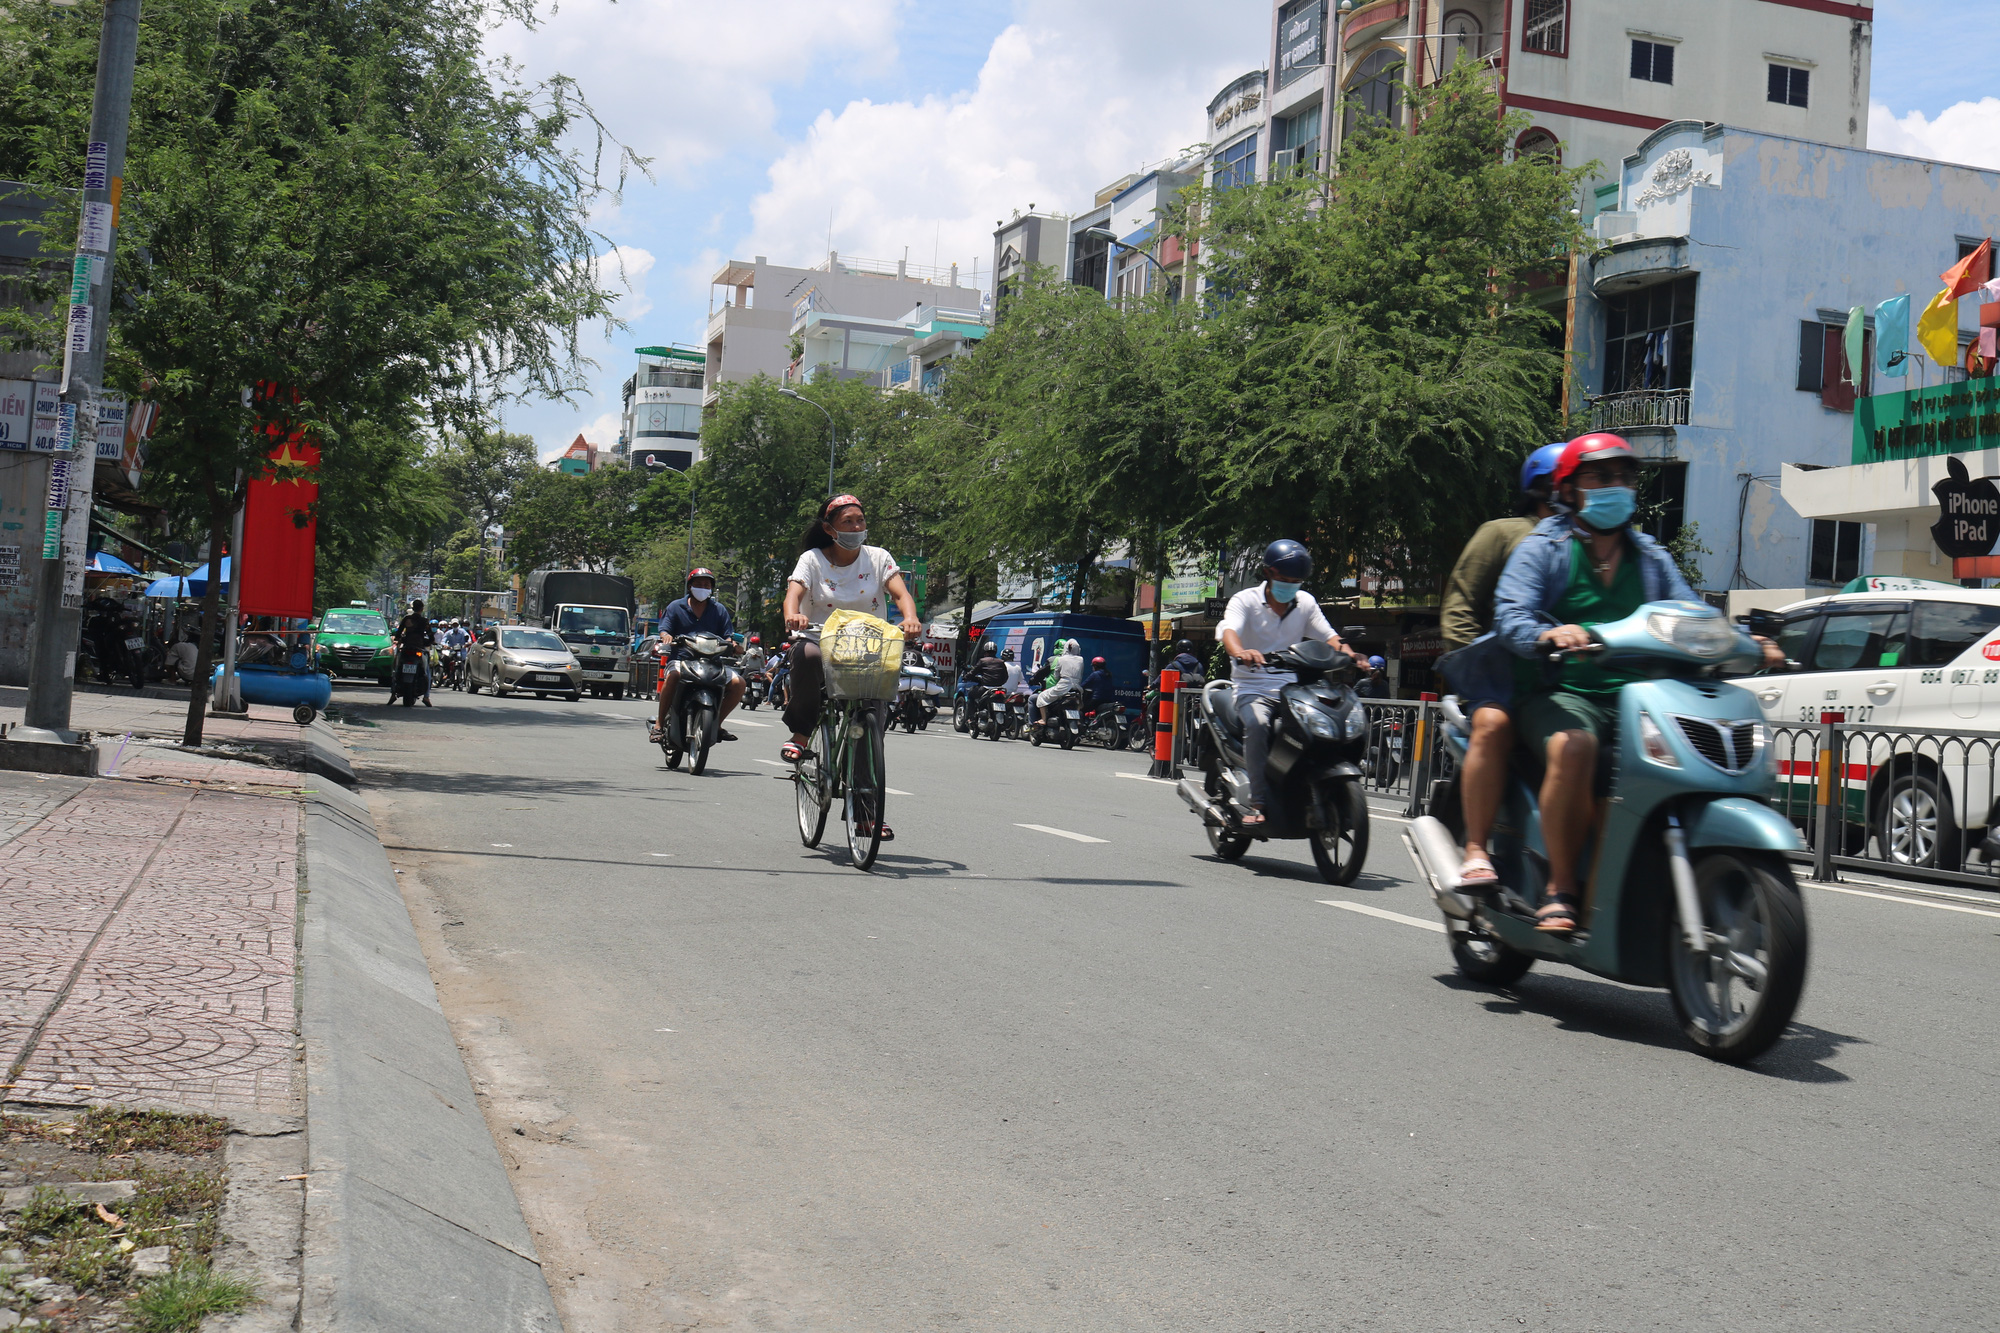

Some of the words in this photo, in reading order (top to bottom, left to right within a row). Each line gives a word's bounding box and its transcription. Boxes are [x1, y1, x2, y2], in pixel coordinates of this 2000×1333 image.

[85, 142, 107, 189] 0916.177.199
[0, 393, 26, 416] IỀN
[35, 436, 55, 449] 40.0
[1948, 493, 1998, 514] iPhone
[1954, 519, 1987, 541] iPad
[932, 642, 951, 653] UA
